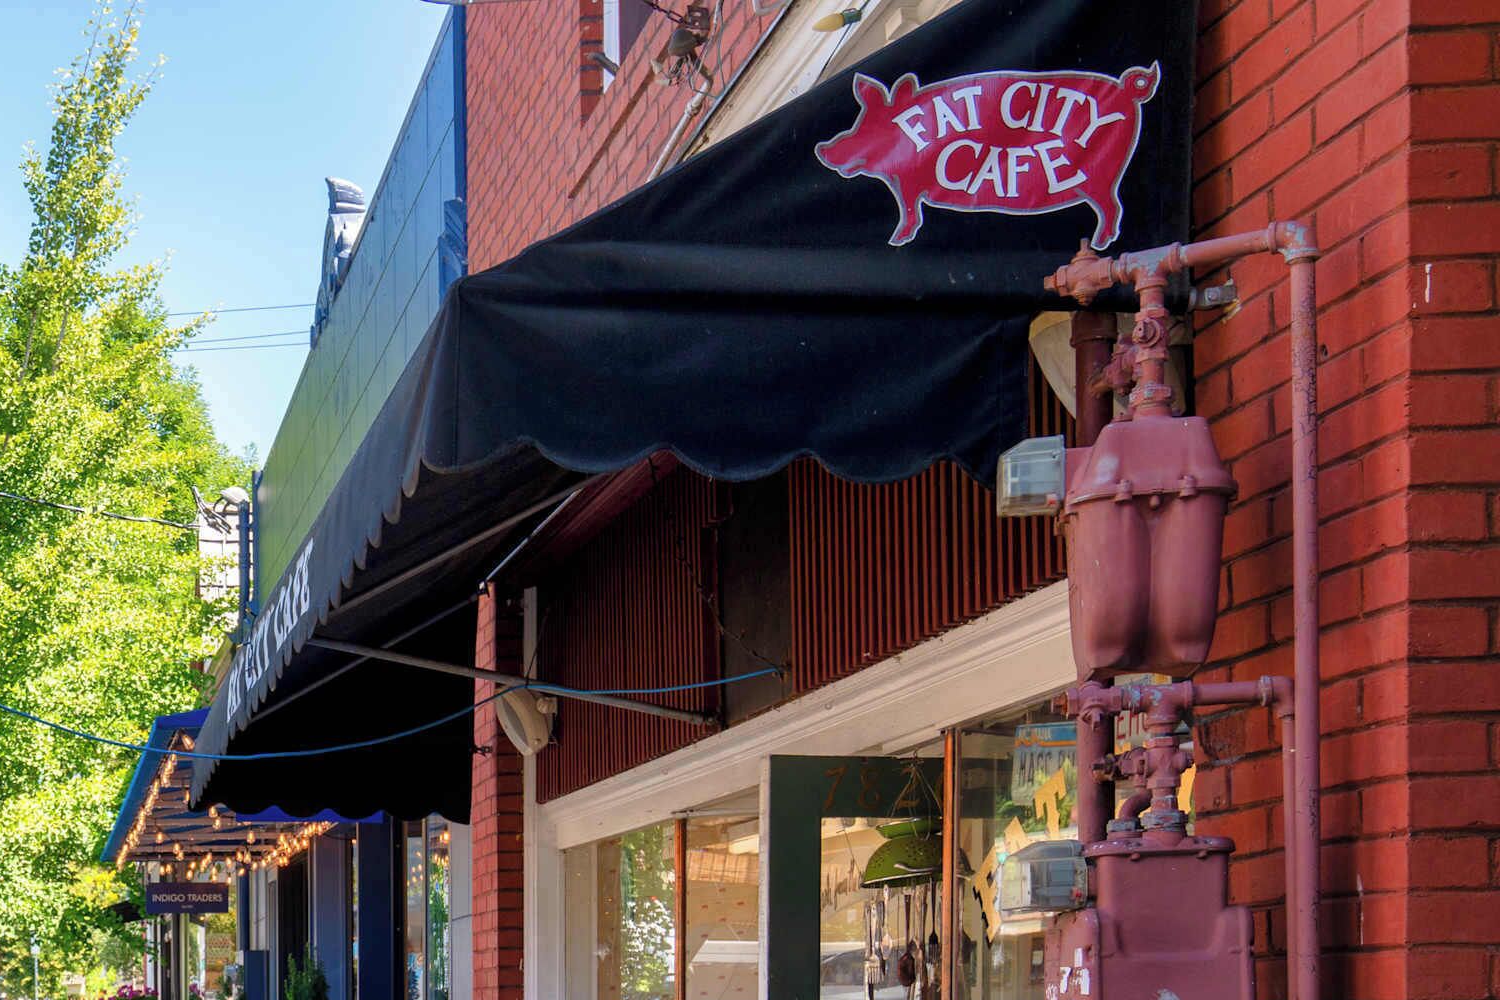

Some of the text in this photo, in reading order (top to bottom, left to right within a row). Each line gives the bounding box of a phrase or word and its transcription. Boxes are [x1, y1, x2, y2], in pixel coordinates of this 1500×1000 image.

[891, 81, 1126, 152] FAT CITY
[935, 139, 1089, 198] CAFE
[245, 600, 276, 692] CITY
[274, 537, 314, 652] CAFE
[823, 764, 944, 812] 782
[152, 893, 223, 903] INDIGO TRADERS
